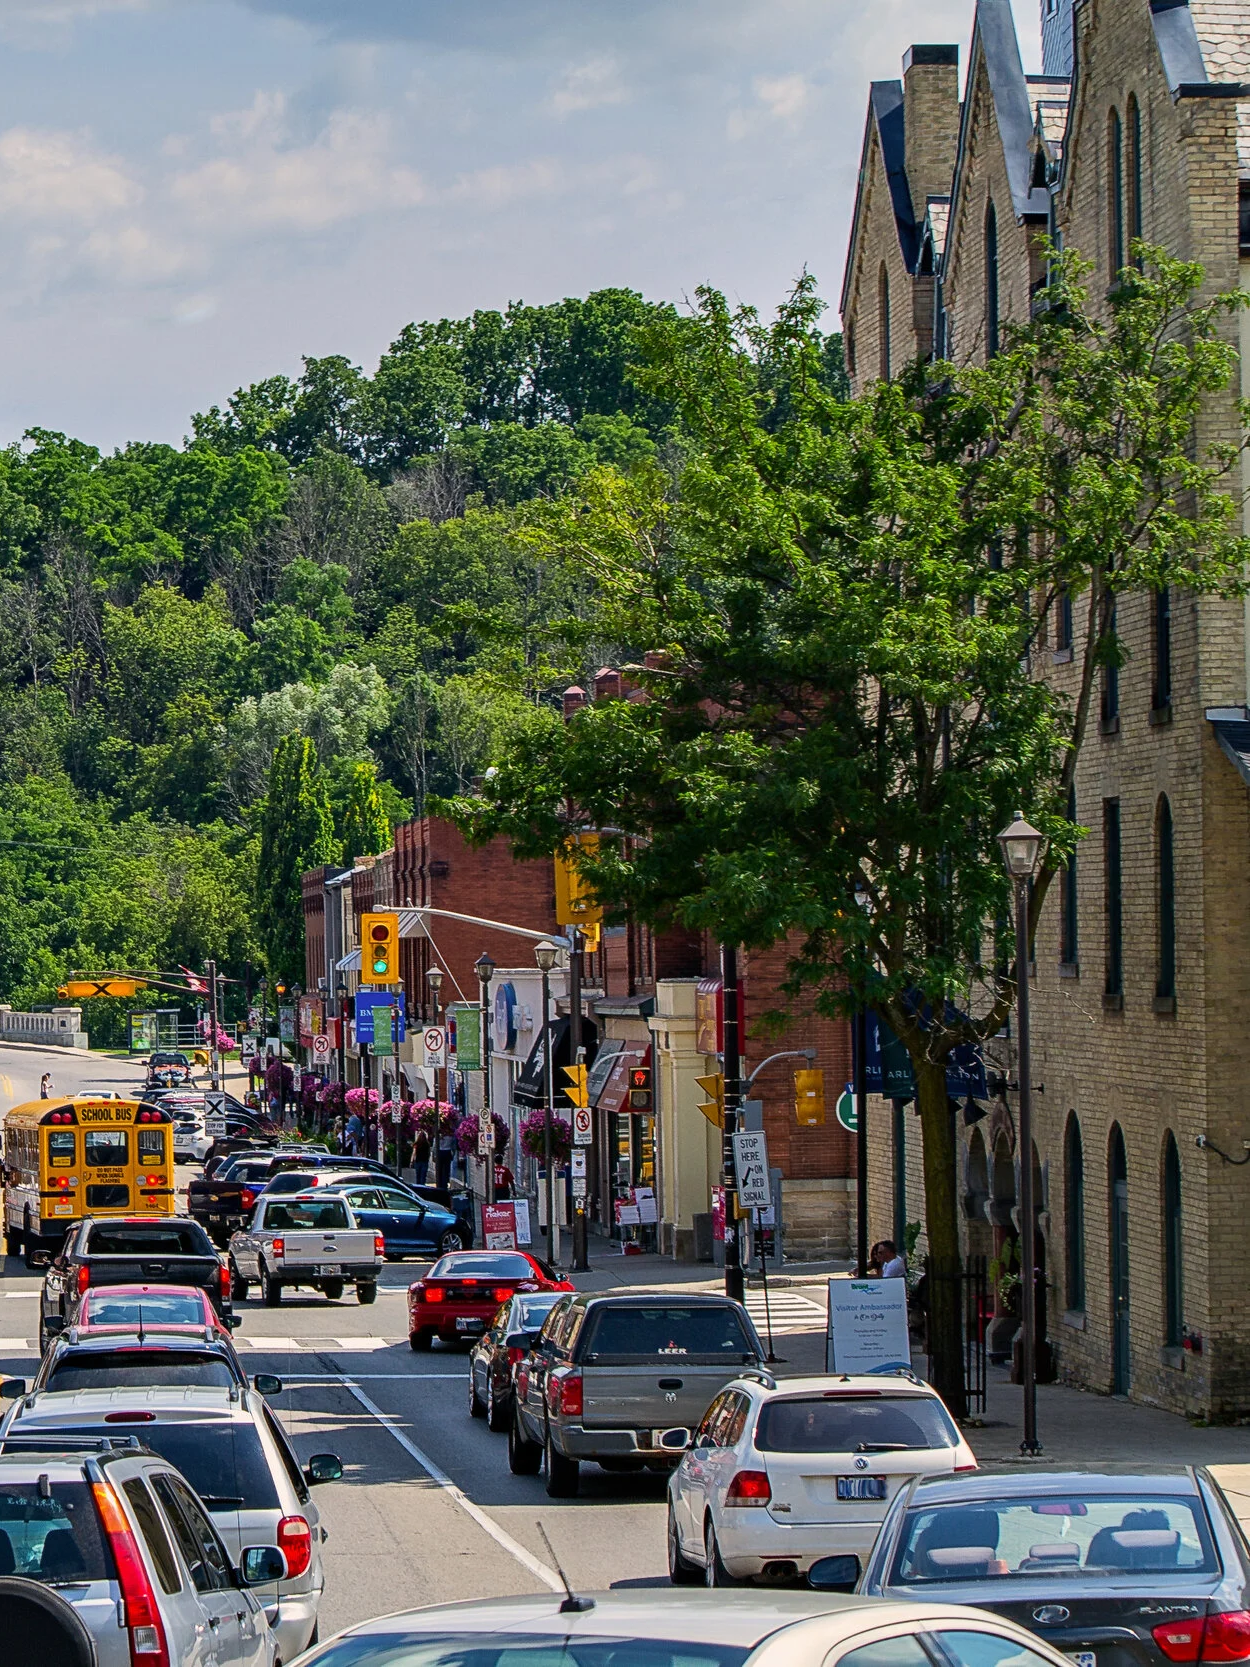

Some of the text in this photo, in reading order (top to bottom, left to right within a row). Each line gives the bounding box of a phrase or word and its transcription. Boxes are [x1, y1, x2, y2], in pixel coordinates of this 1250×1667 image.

[82, 1108, 132, 1121] SCHOOL BUS
[740, 1139, 758, 1149] STOP
[741, 1152, 760, 1162] HERE
[755, 1165, 763, 1174] ON
[752, 1178, 764, 1188] RED
[744, 1191, 766, 1202] SIGNAL
[1139, 1606, 1199, 1614] ELANTRA
